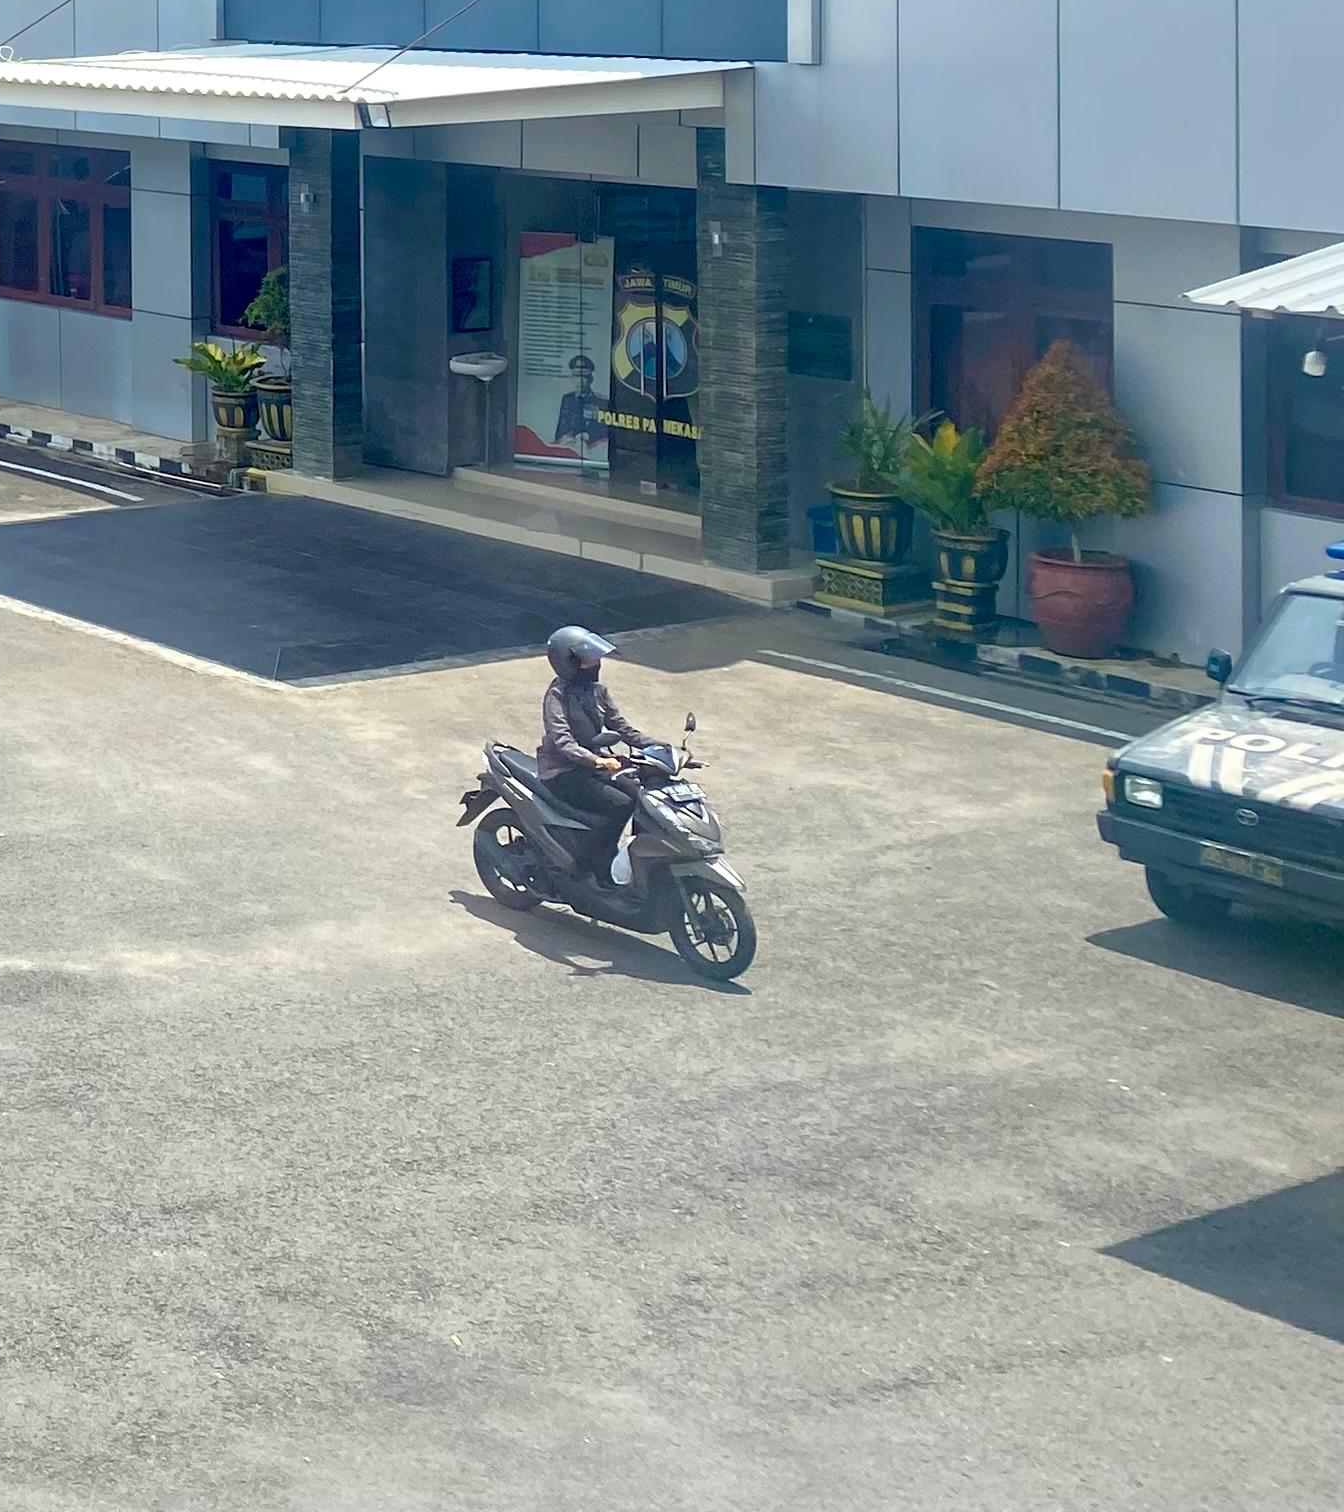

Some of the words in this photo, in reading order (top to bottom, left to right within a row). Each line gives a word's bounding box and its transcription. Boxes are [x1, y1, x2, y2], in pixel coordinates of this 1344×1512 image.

[623, 277, 653, 289] JAWA
[663, 279, 693, 295] TIMUR
[597, 410, 641, 431] POLRES
